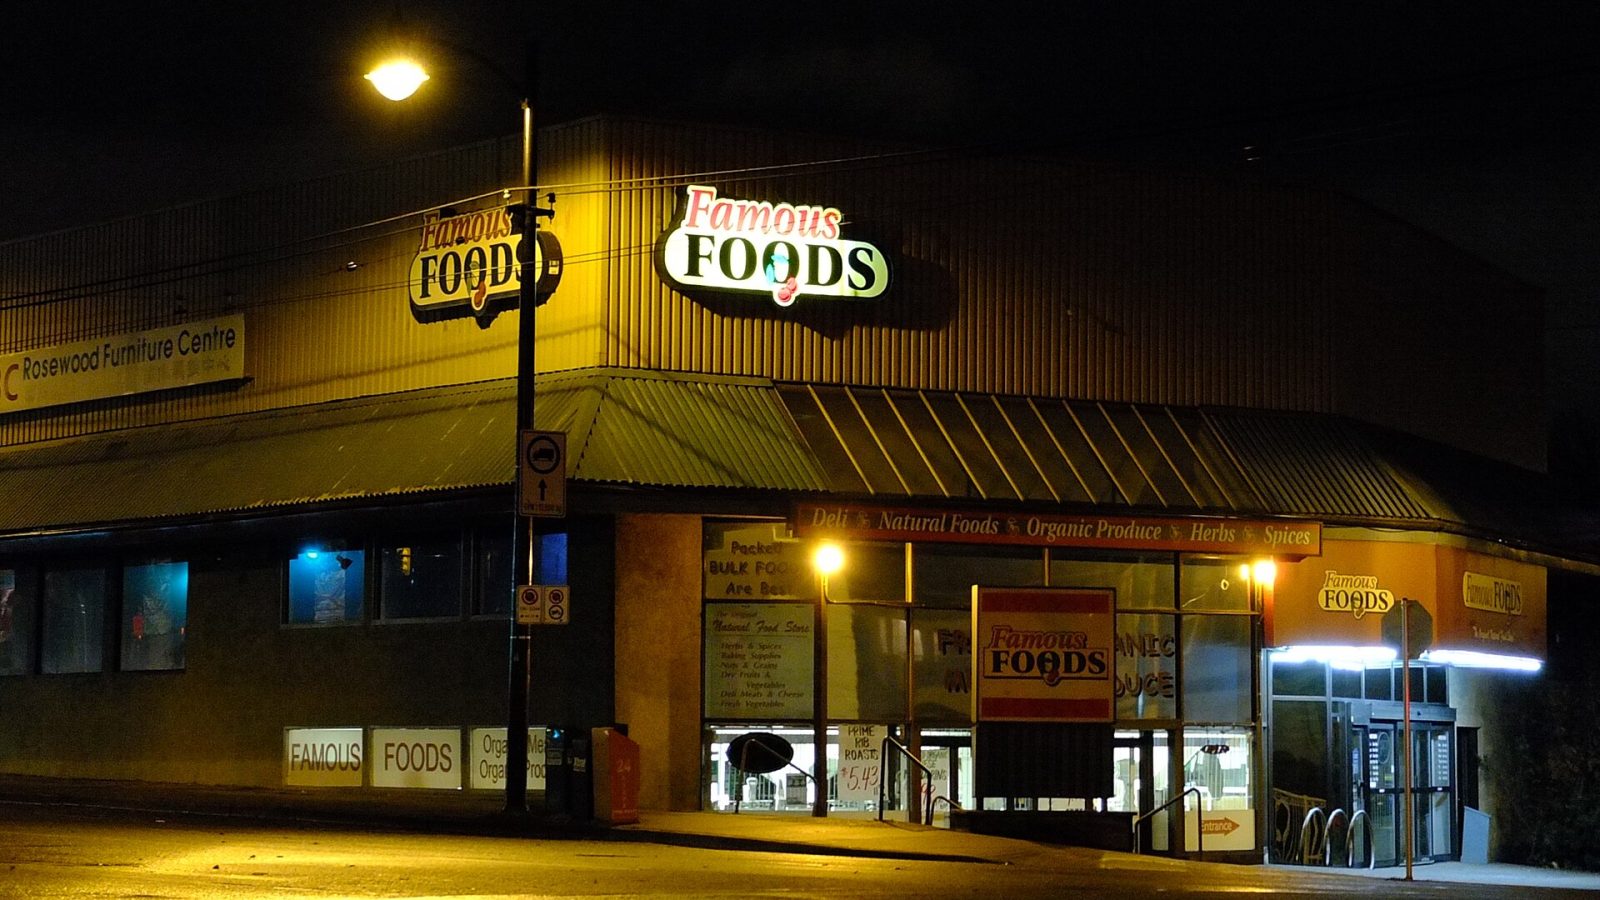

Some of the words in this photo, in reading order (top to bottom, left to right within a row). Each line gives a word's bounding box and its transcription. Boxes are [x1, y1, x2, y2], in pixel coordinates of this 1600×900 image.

[686, 188, 839, 239] Famous
[421, 208, 511, 251] Famous
[684, 234, 876, 290] FOODS
[23, 346, 99, 380] Rosewood
[104, 337, 173, 368] Furniture
[178, 325, 236, 356] Centre
[0, 362, 19, 401] C
[812, 507, 848, 528] Deli
[878, 511, 946, 532] Natural
[950, 513, 999, 535] Foods
[1027, 517, 1093, 542] Organic
[1096, 519, 1162, 540] Produce
[1190, 523, 1235, 542] Herbs
[1264, 525, 1311, 547] Spices
[709, 560, 748, 576] BULK
[755, 561, 800, 576] FOO
[1325, 571, 1377, 589] Famous
[725, 582, 753, 595] Are
[761, 581, 791, 595] Bes
[1325, 590, 1389, 610] FOODS
[1494, 581, 1521, 611] FOODS
[713, 619, 750, 632] Natural
[756, 620, 779, 633] Food
[989, 625, 1088, 649] Famous
[1116, 632, 1175, 657] ANIC
[991, 650, 1106, 675] FOODS
[1116, 673, 1174, 697] DUCE
[848, 725, 875, 737] PRIME
[855, 737, 870, 748] RIB
[291, 743, 361, 771] FAMOUS
[384, 742, 452, 773] FOODS
[483, 734, 508, 758] Orga
[845, 748, 879, 760] ROASTS
[479, 759, 507, 783] Orga
[841, 765, 879, 791] $5.43
[1202, 820, 1233, 832] Entrance
